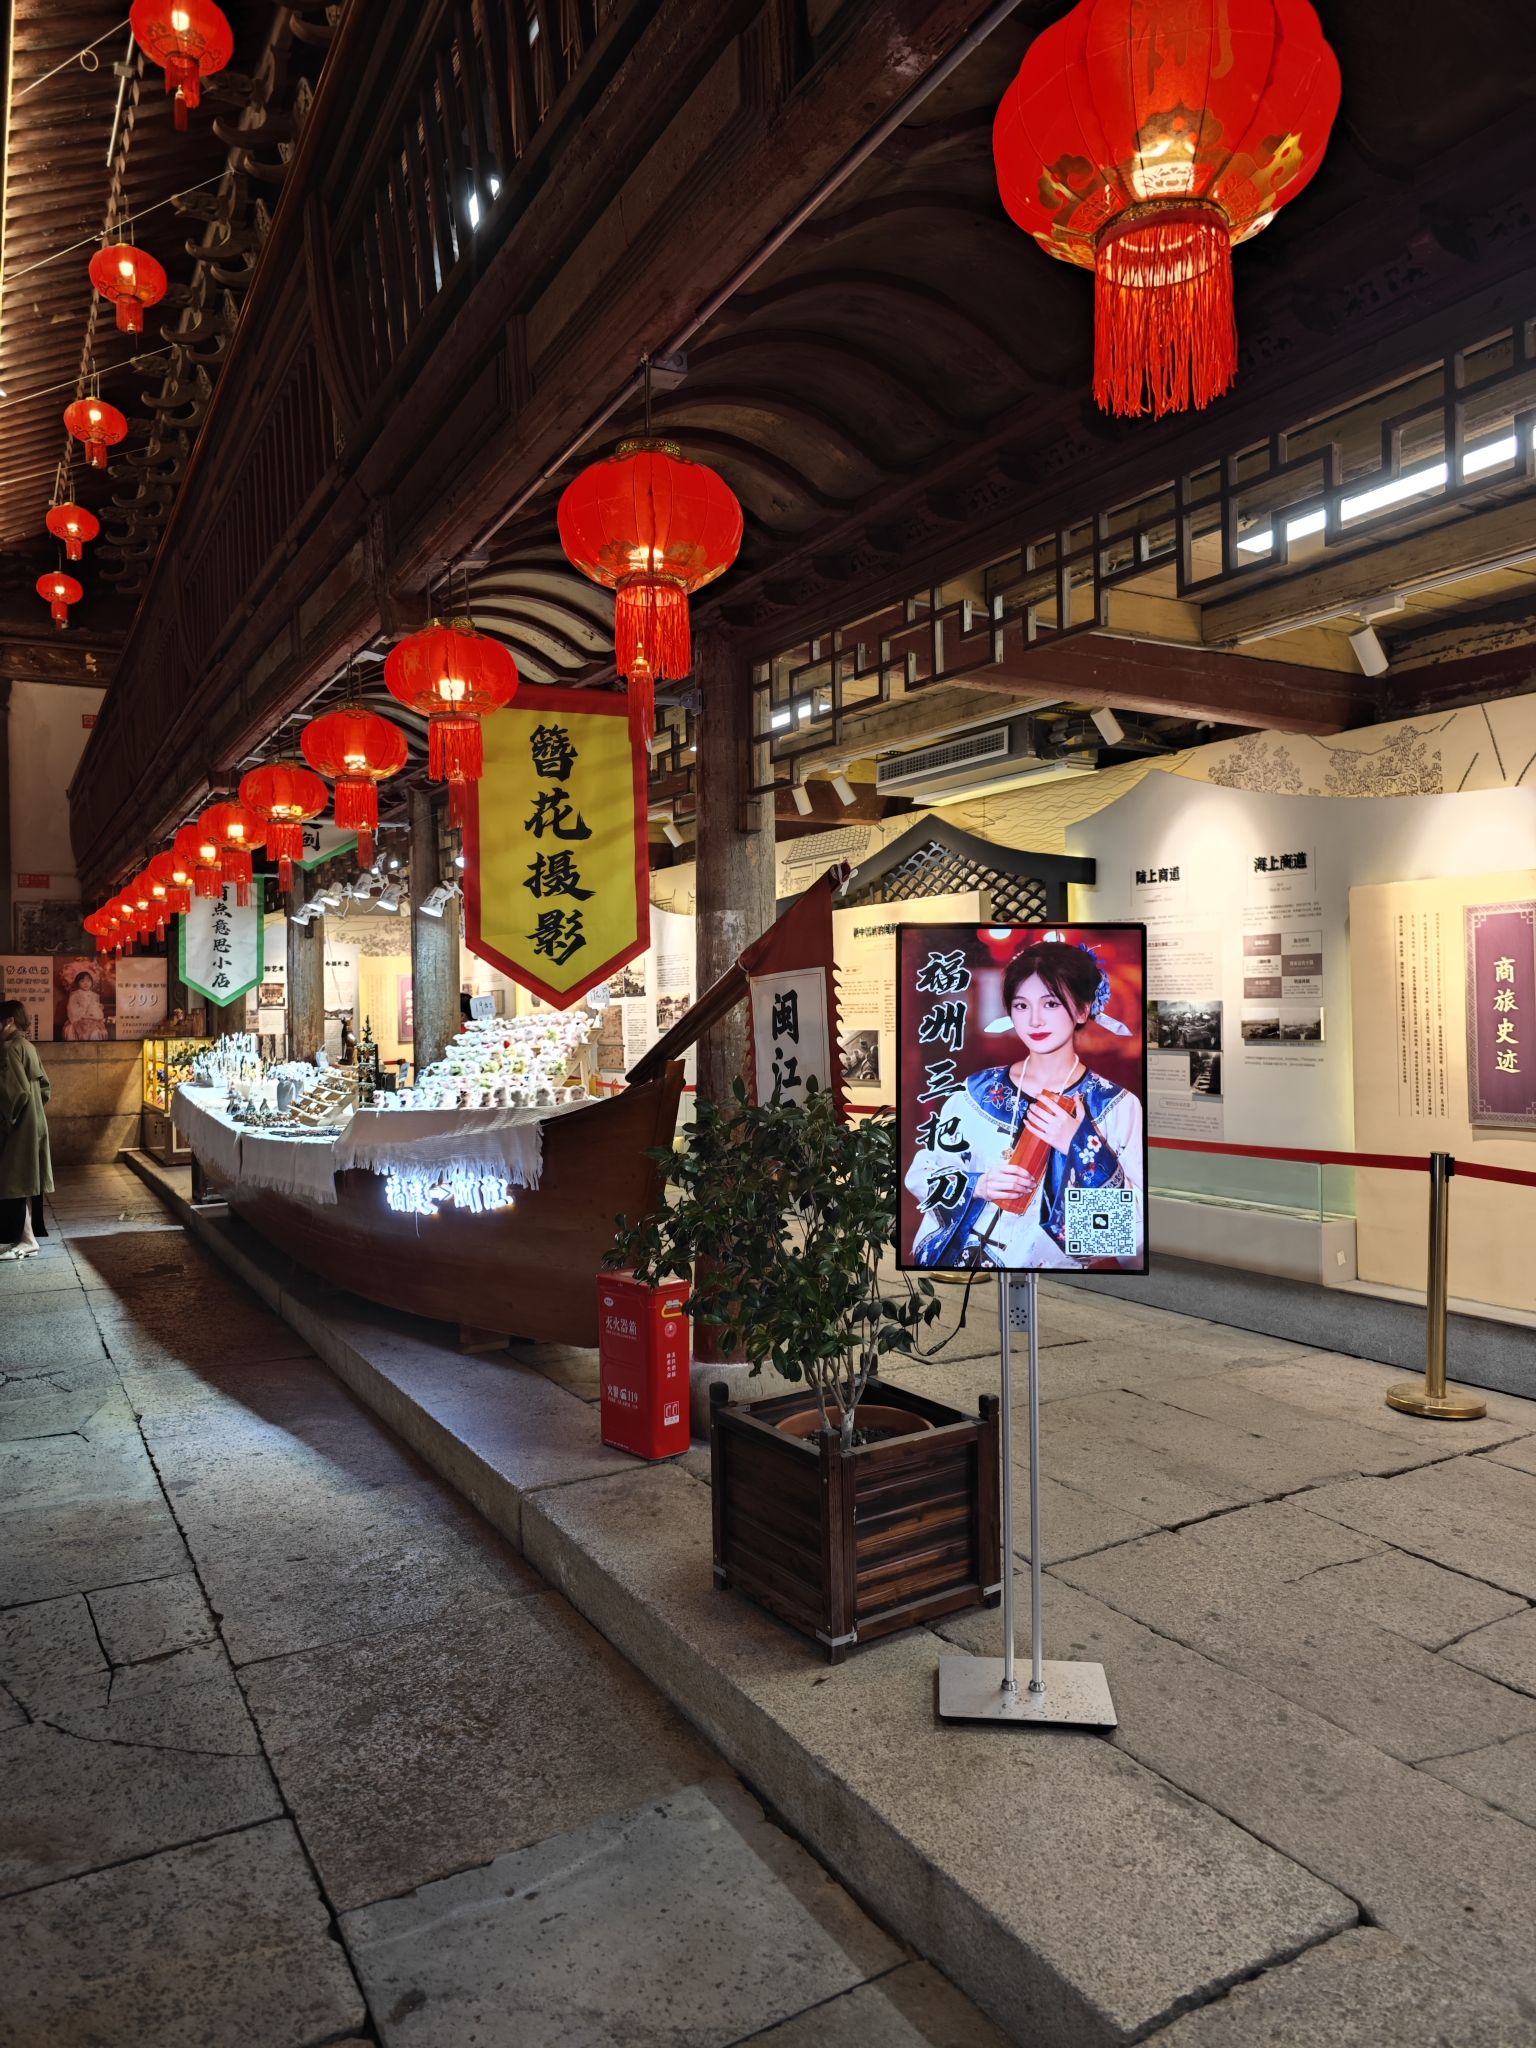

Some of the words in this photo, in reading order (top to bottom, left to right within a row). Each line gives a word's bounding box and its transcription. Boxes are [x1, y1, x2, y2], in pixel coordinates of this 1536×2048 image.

[523, 724, 597, 966] 簪花摄影
[1253, 852, 1307, 873] 海上商道
[128, 992, 159, 1008] 299
[772, 989, 802, 1108] 闽江
[1493, 957, 1520, 1073] 商旅史迹
[916, 949, 971, 1213] 福州三把刀
[606, 1316, 637, 1336] 灭火器箱
